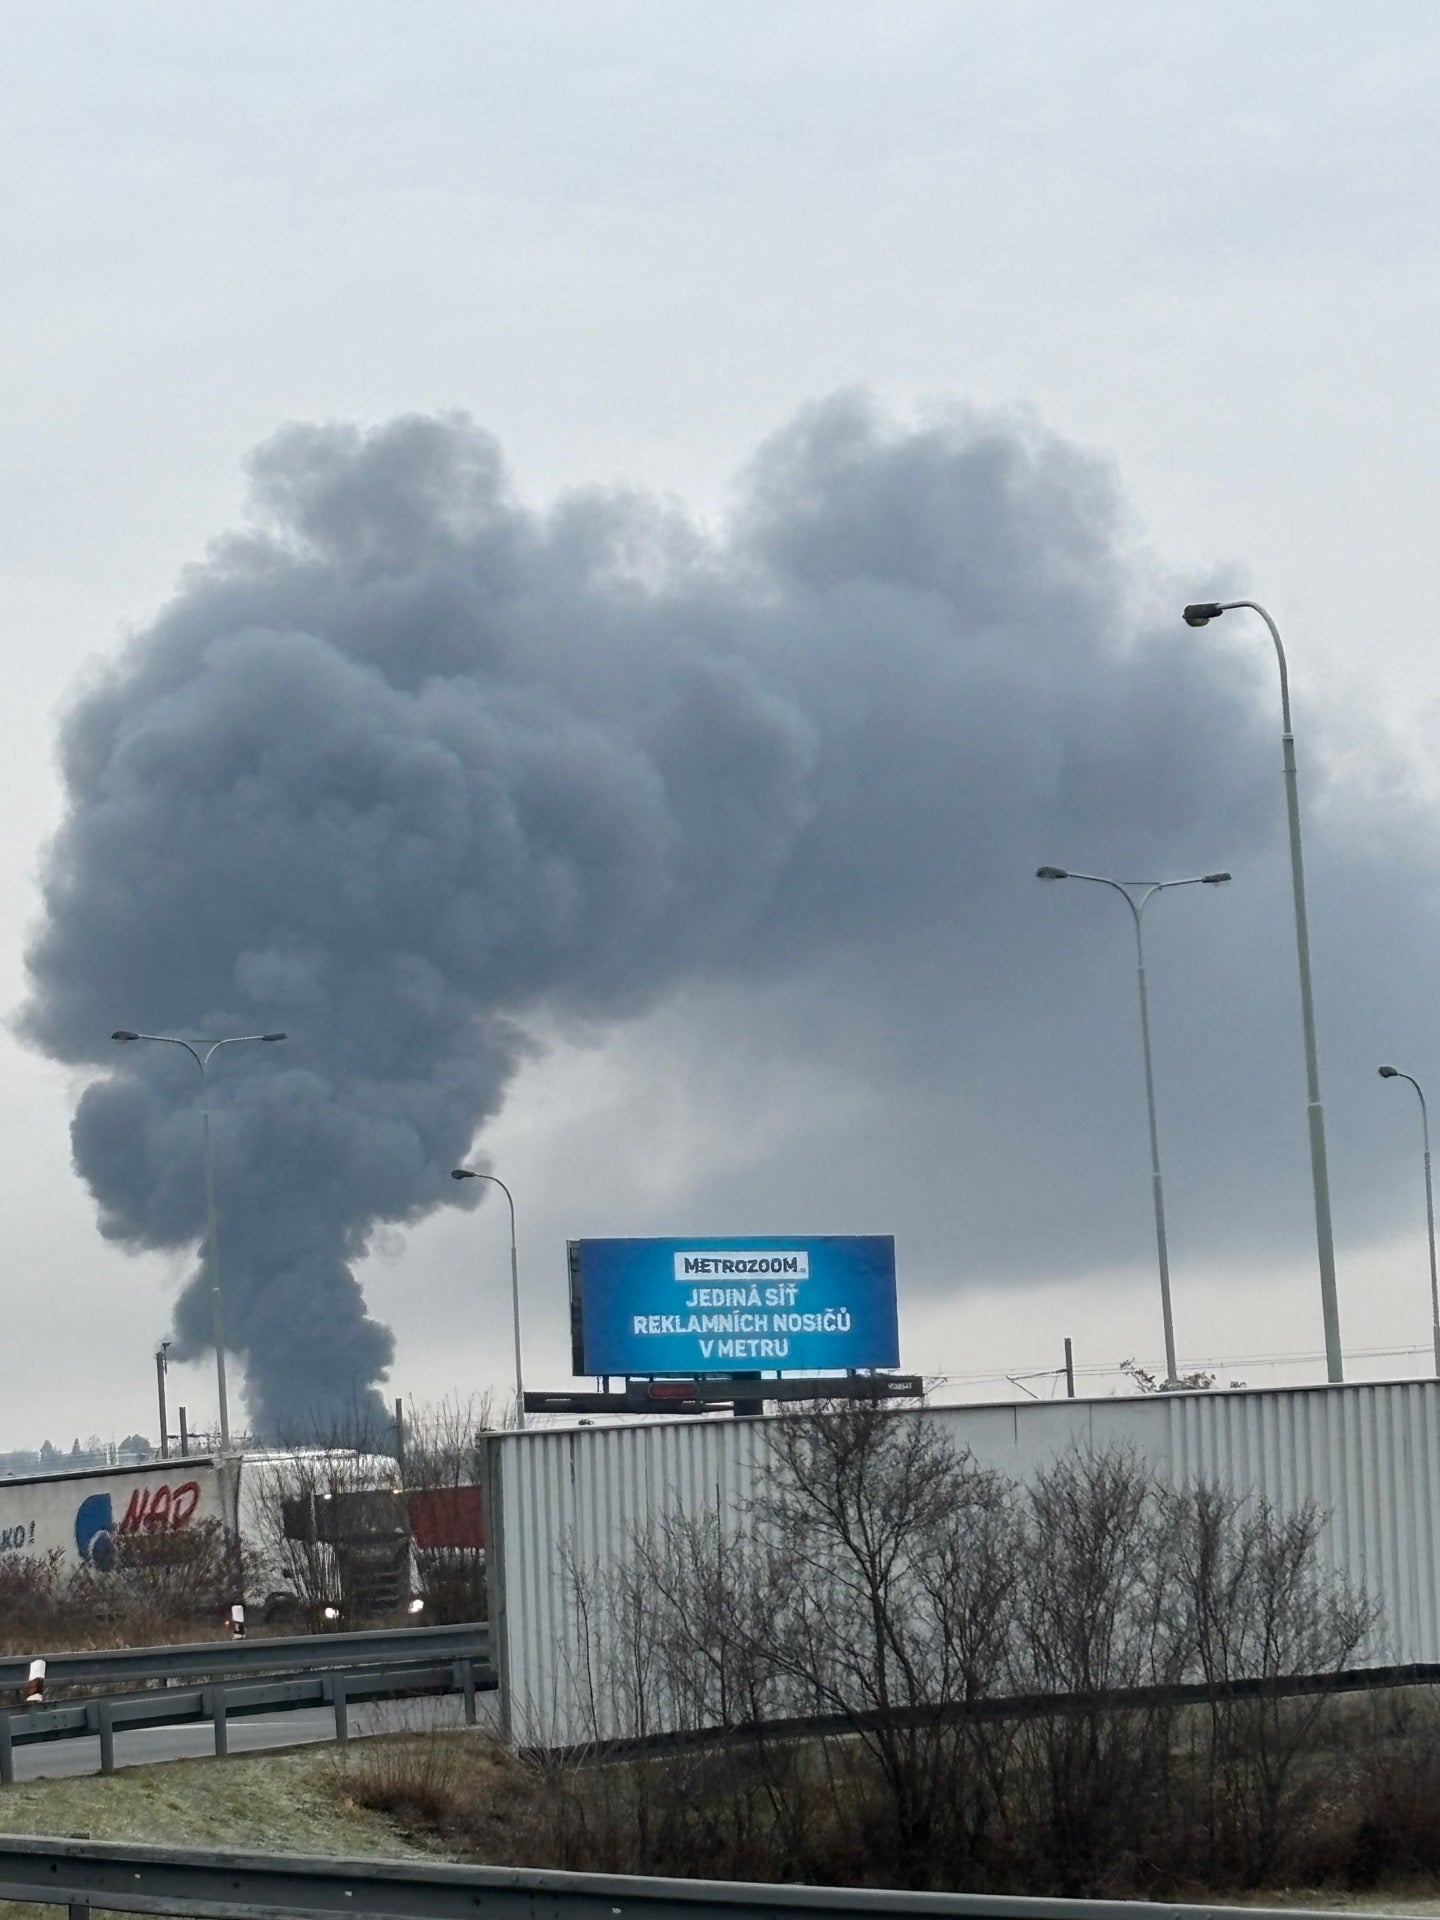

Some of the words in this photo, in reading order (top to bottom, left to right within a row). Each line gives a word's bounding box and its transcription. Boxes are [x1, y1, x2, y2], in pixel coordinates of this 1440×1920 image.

[684, 1257, 798, 1274] METROZOOM
[686, 1284, 762, 1308] JEDINÁ
[765, 1283, 799, 1307] SÍŤ
[633, 1310, 768, 1335] REKLAMNÍCH
[773, 1306, 851, 1333] NOSIČŮ
[699, 1340, 714, 1359] V
[718, 1338, 789, 1358] METRU
